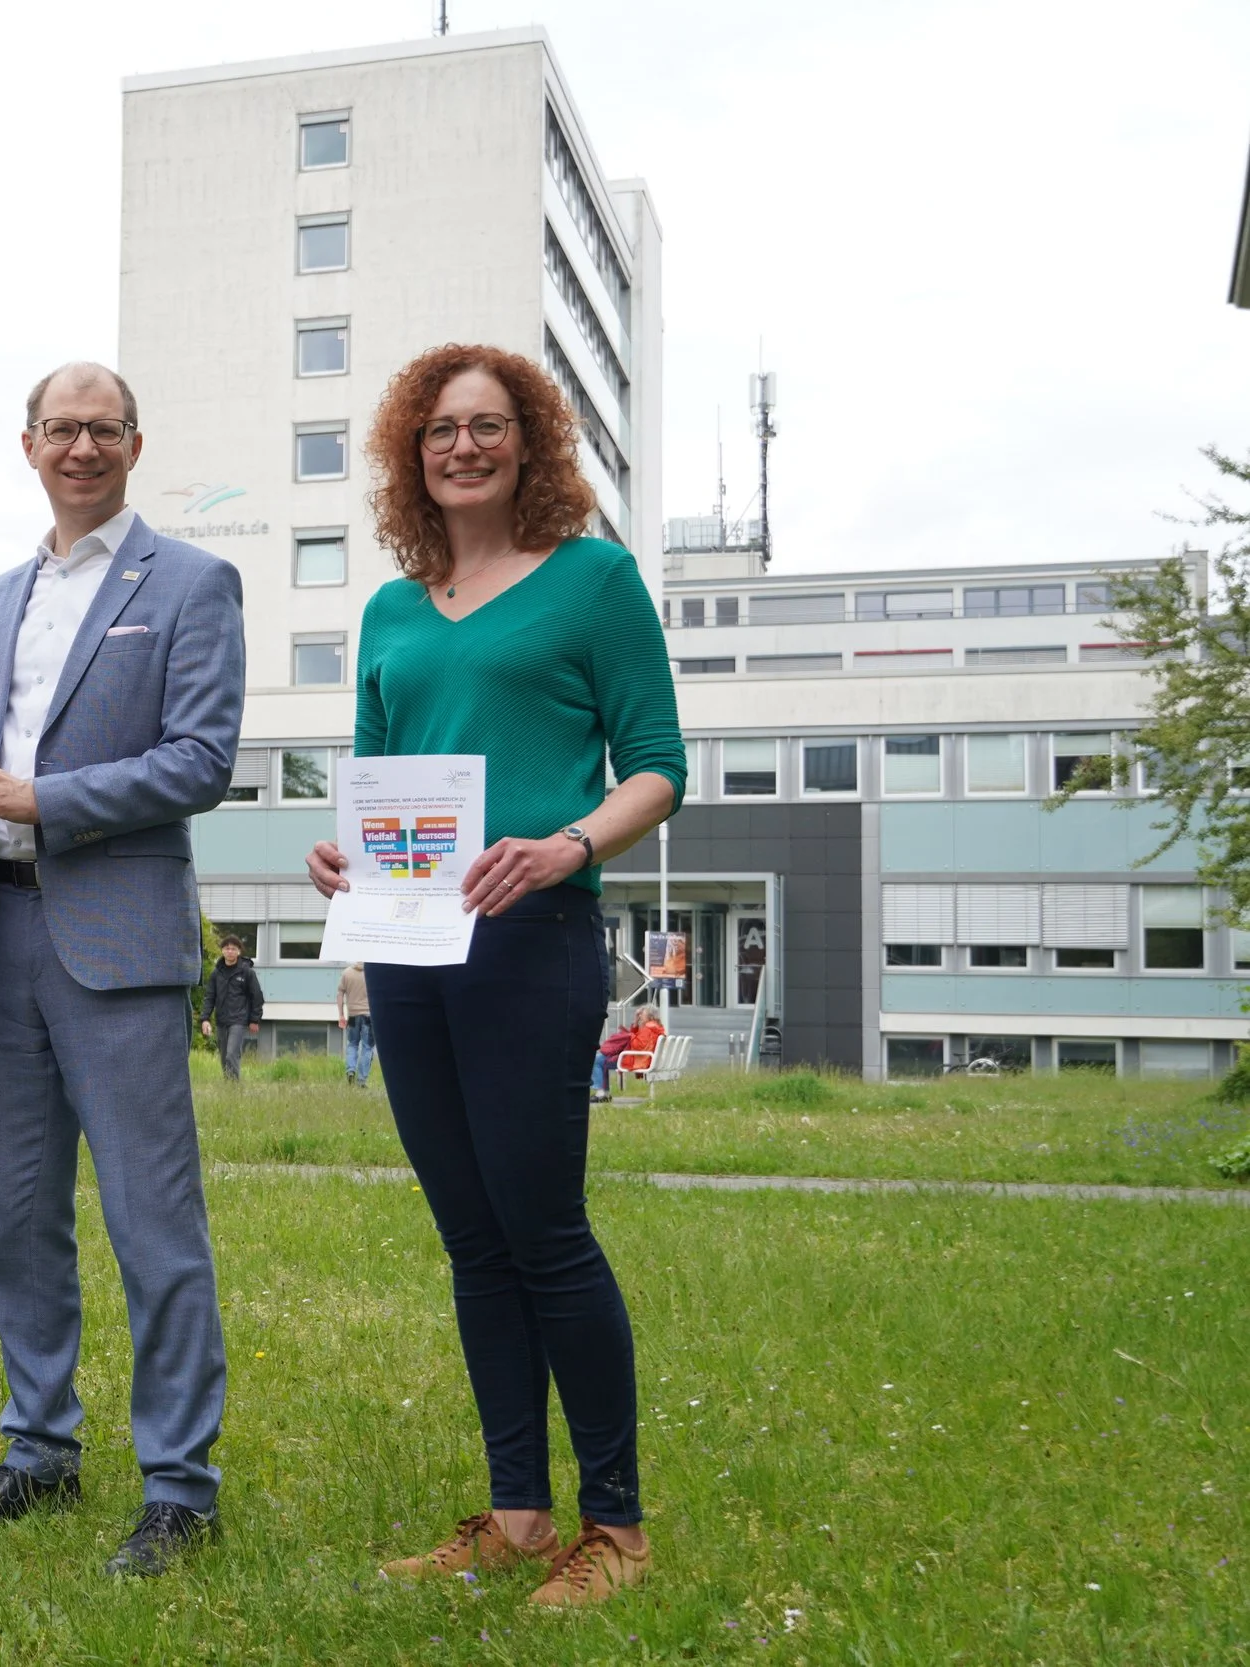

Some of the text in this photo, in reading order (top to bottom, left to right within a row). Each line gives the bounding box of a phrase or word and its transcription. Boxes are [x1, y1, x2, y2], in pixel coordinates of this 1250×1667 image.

[158, 519, 269, 539] tteraukreis.de
[364, 821, 385, 829] Wenn
[366, 832, 397, 841] Vielfalt
[368, 843, 397, 851] gewinnt,
[413, 843, 454, 851] DIVERSITY
[743, 927, 764, 950] A
